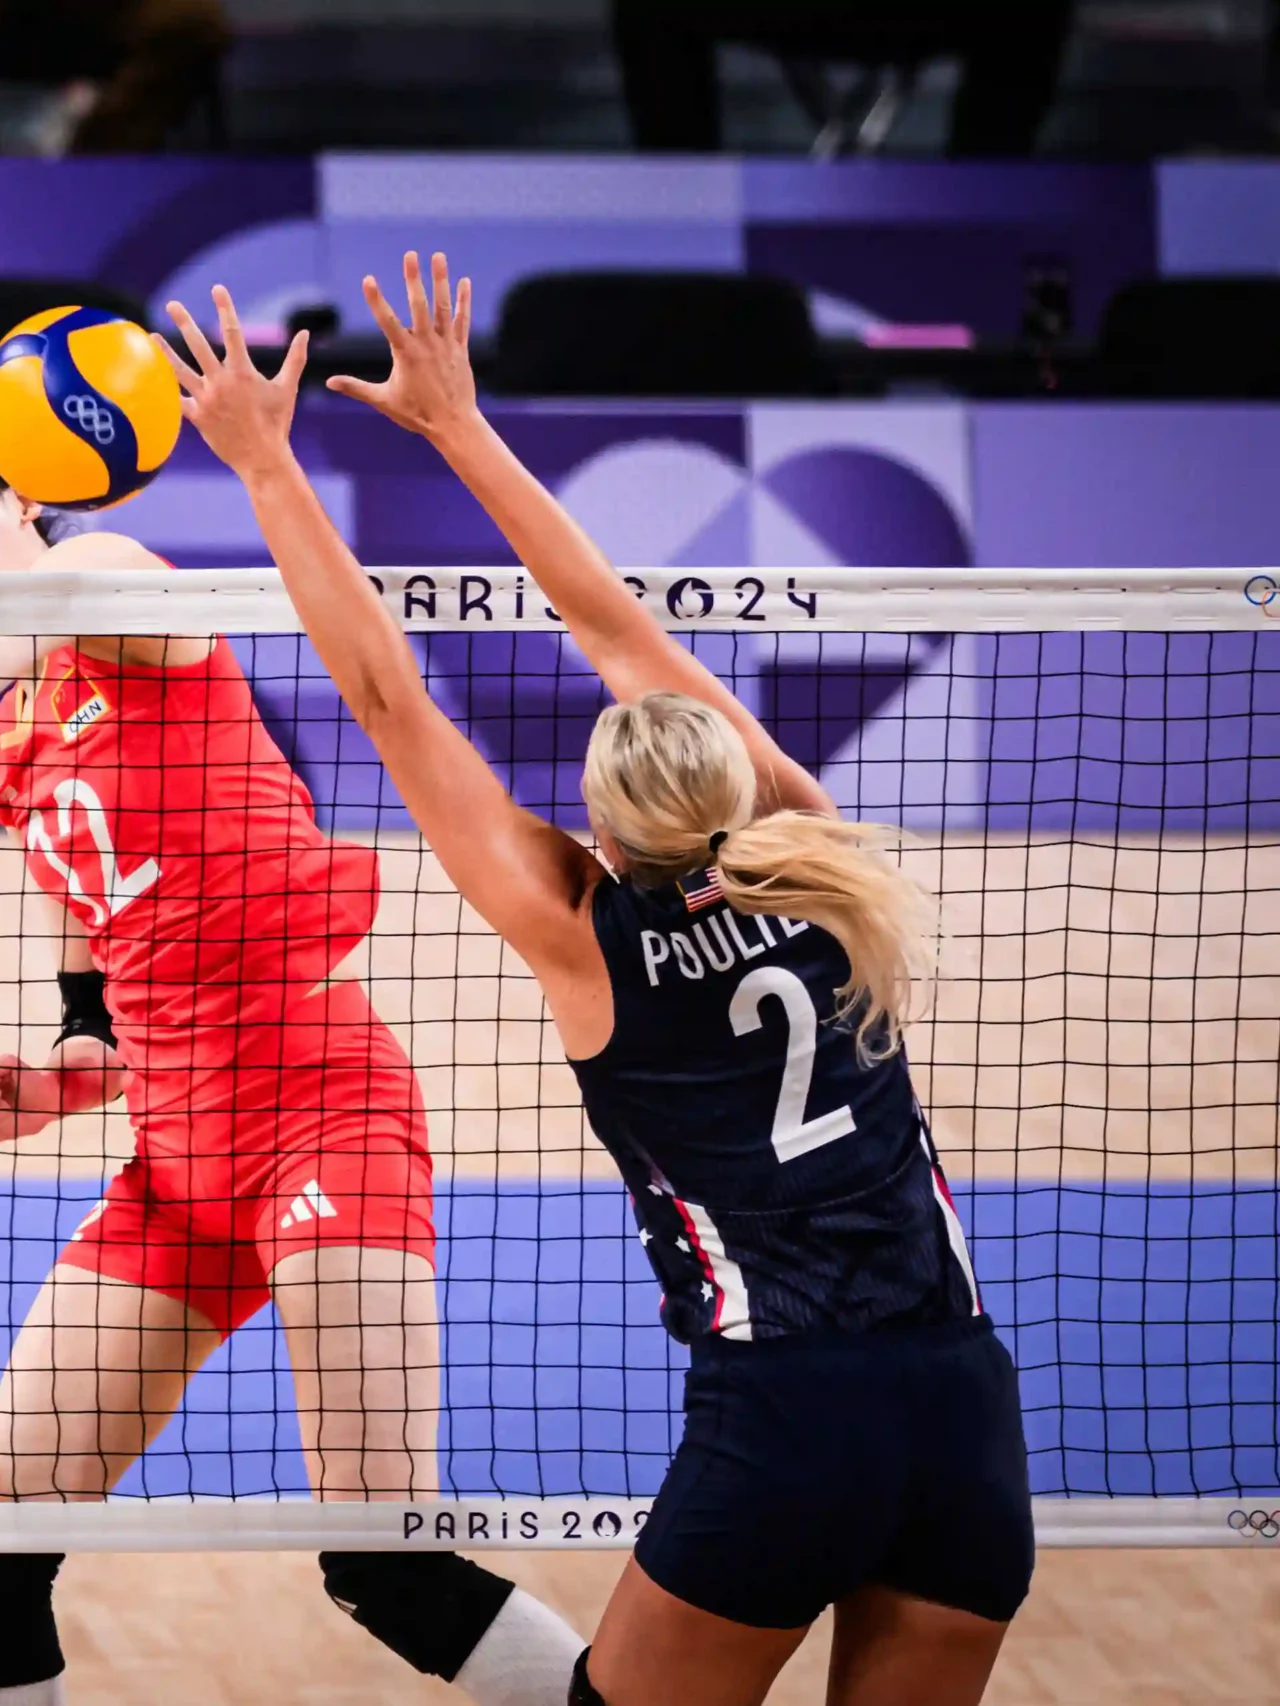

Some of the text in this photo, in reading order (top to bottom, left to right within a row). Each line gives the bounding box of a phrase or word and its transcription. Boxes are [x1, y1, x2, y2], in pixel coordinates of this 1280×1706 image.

[367, 575, 563, 621] ARi
[640, 907, 809, 987] POUL
[728, 966, 857, 1164] 2
[562, 1511, 651, 1539] 202
